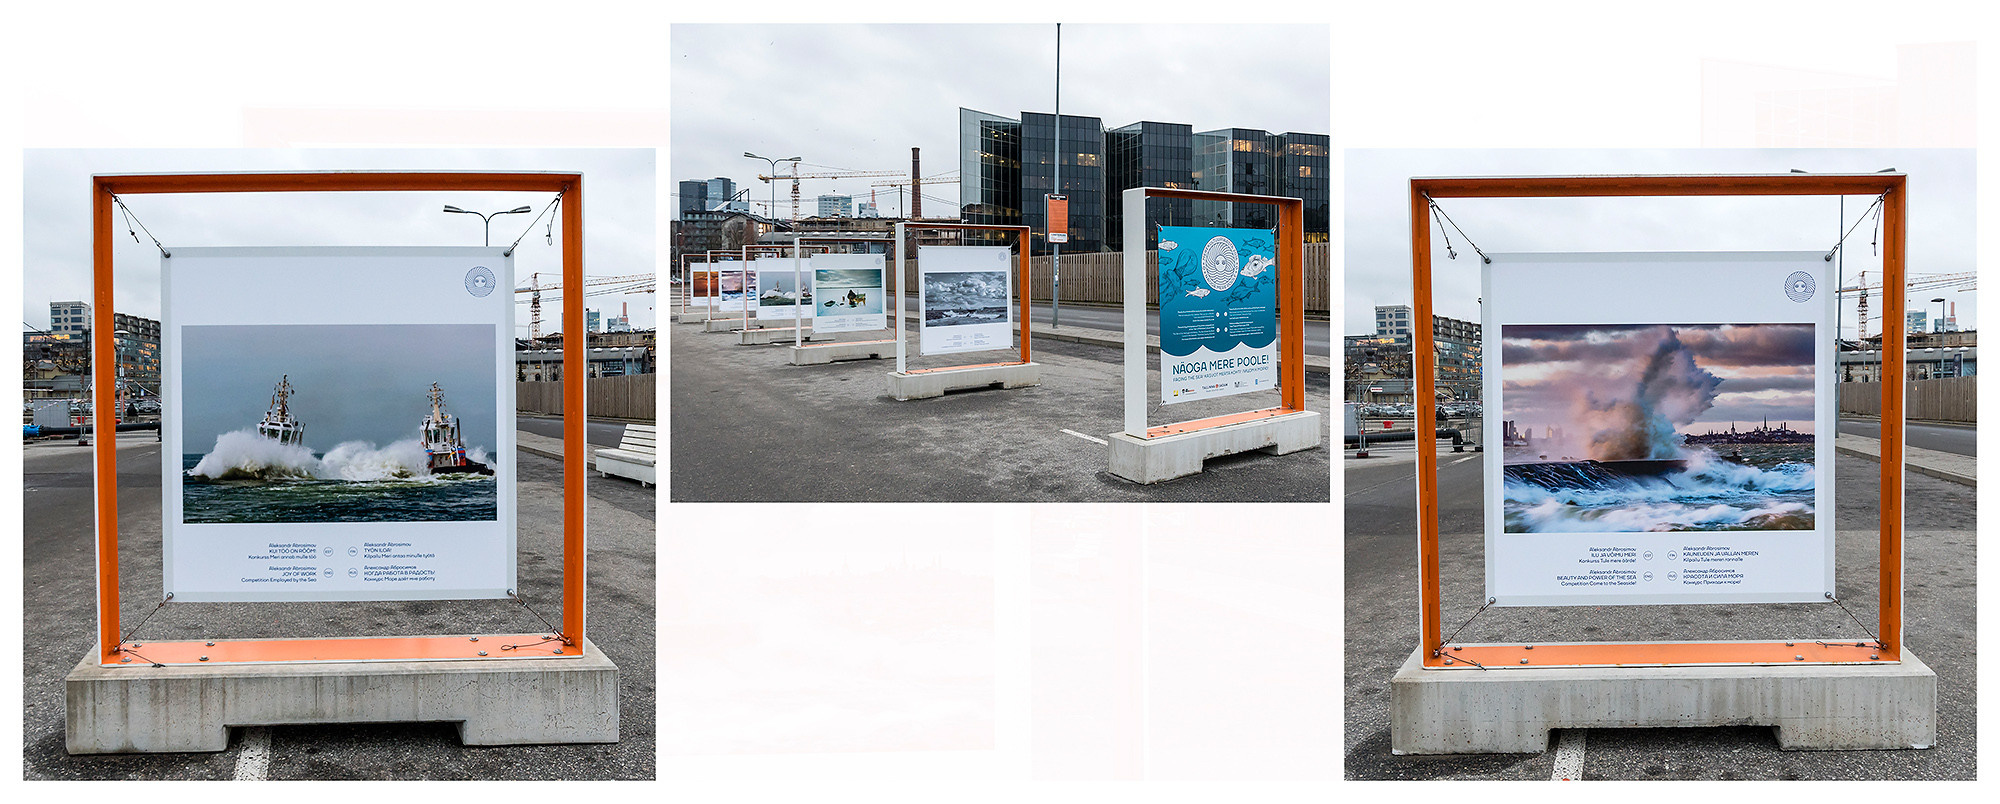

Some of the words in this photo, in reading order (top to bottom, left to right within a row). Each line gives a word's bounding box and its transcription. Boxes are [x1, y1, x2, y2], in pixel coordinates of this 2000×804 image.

[1172, 362, 1207, 375] NÄOGA
[1209, 358, 1234, 371] MERE
[1237, 354, 1269, 367] POOLE!
